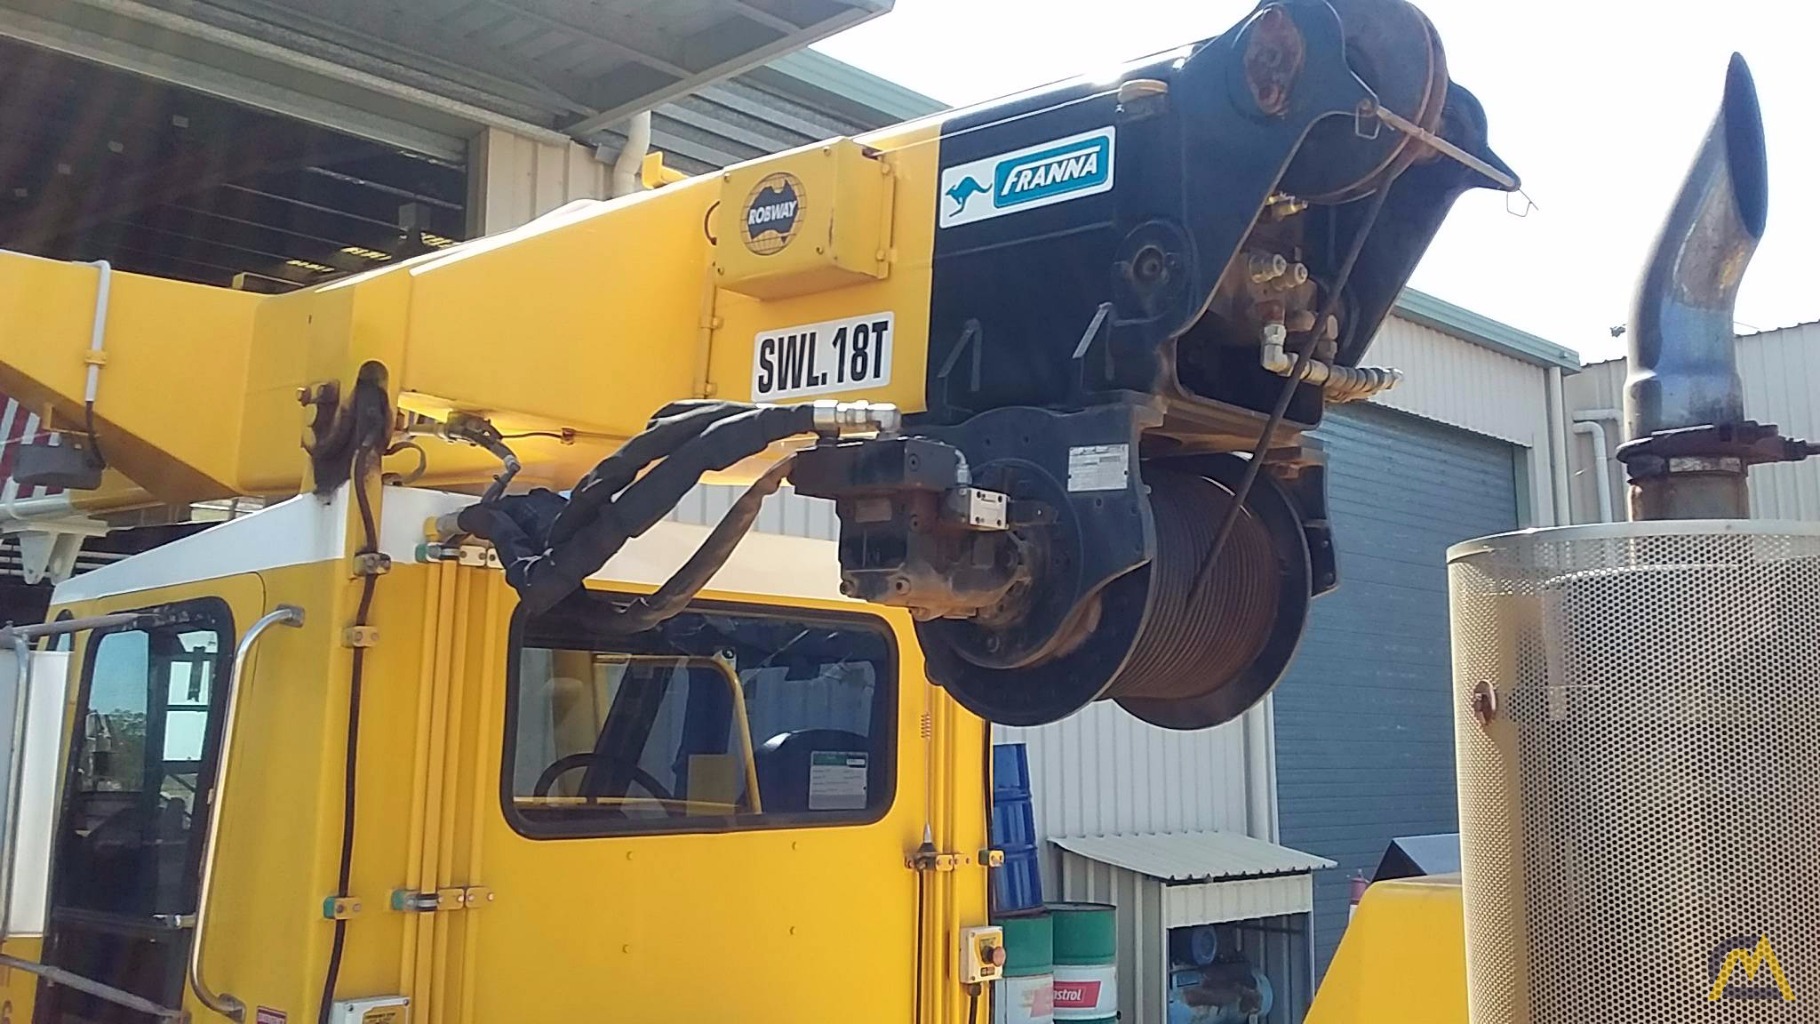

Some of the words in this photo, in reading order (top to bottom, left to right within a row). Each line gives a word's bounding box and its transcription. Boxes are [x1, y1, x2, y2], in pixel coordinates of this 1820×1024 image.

[1001, 145, 1102, 196] FRANNA
[748, 200, 798, 225] ROBWAY
[1053, 989, 1082, 1001] astrol
